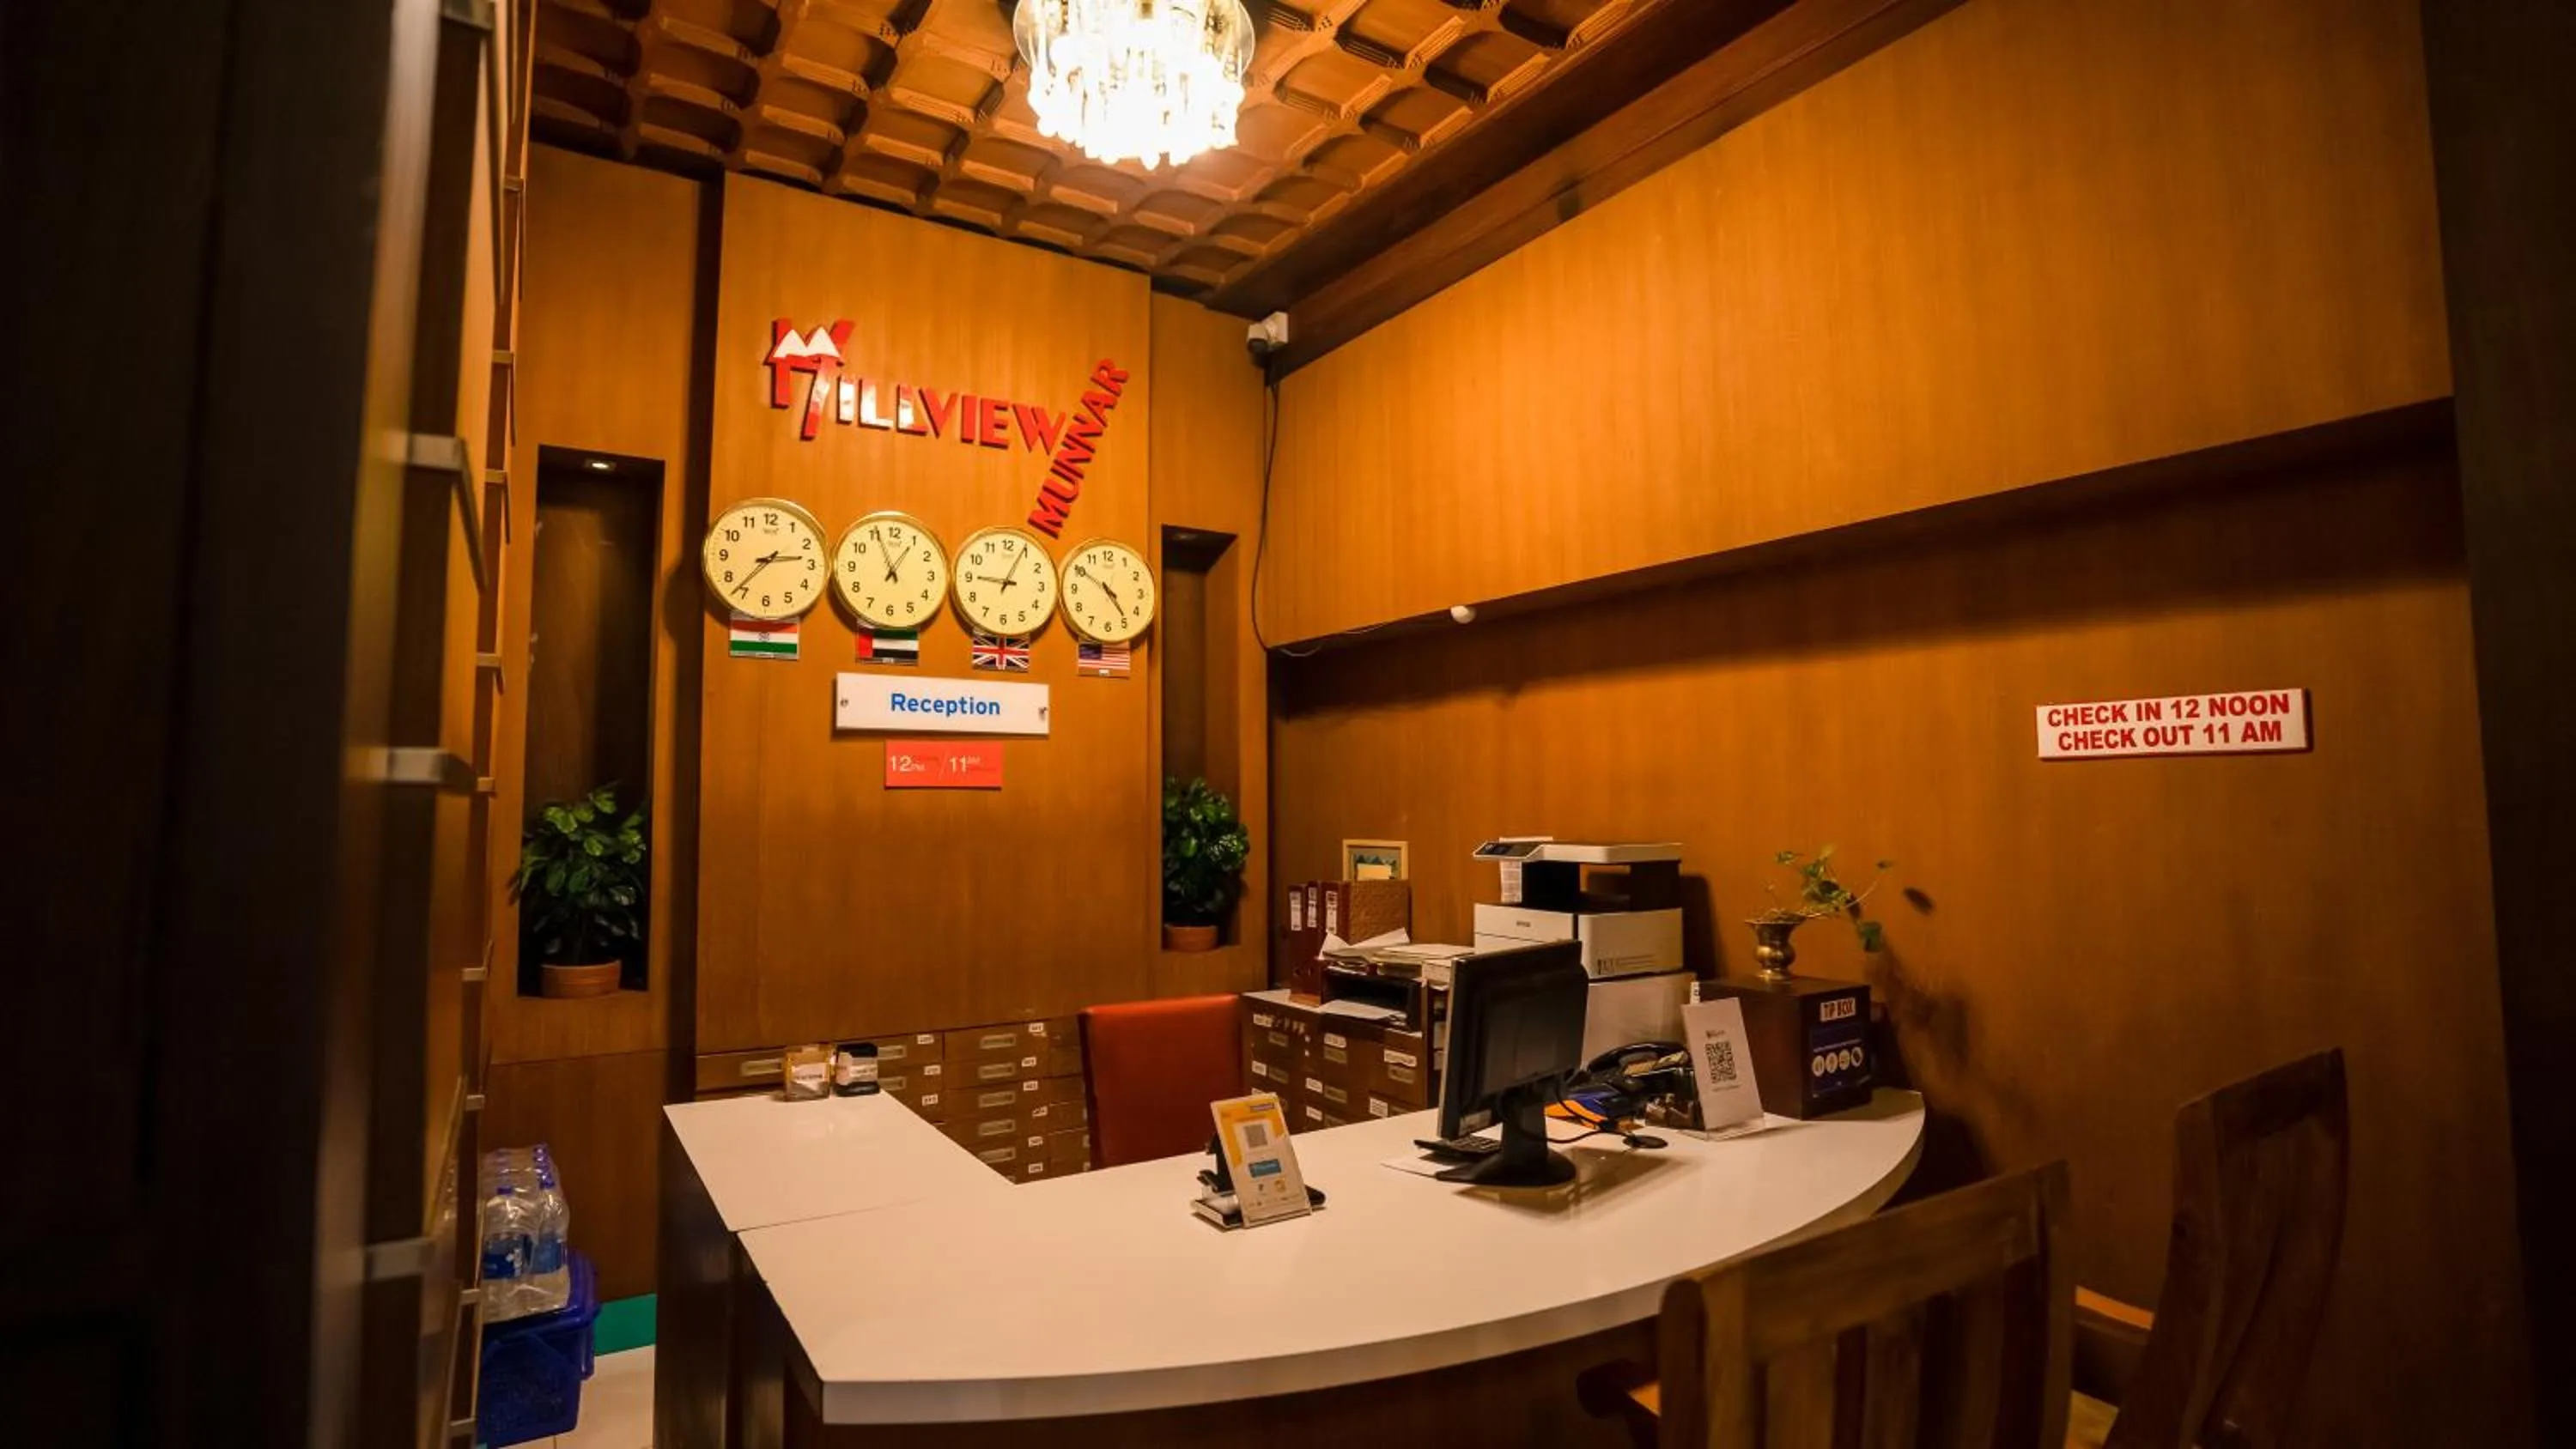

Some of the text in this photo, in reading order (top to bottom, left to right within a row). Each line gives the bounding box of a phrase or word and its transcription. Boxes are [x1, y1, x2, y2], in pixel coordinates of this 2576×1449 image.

[1028, 357, 1129, 539] MUNNAR
[744, 517, 755, 528] 11
[764, 513, 779, 525] 12
[790, 522, 796, 532] 1
[726, 530, 739, 541] 10
[889, 527, 901, 539] 12
[803, 538, 811, 549] 2
[911, 535, 917, 546] 1
[1002, 541, 1014, 551] 12
[854, 543, 866, 554] 10
[985, 543, 995, 553] 11
[1023, 547, 1028, 558] 1
[719, 549, 728, 561] 9
[923, 551, 932, 561] 2
[971, 555, 982, 565] 10
[1087, 555, 1097, 564] 11
[1103, 551, 1114, 561] 12
[807, 560, 816, 570] 3
[848, 561, 855, 573] 9
[1122, 557, 1127, 567] 1
[1034, 563, 1042, 573] 2
[725, 572, 732, 582] 8
[927, 571, 935, 582] 3
[965, 573, 972, 582] 9
[1133, 572, 1139, 581] 2
[800, 579, 809, 590] 4
[852, 581, 860, 592] 8
[1038, 582, 1045, 592] 3
[1072, 584, 1078, 593] 9
[738, 586, 749, 599] 7
[784, 591, 793, 603] 5
[921, 590, 928, 599] 4
[969, 592, 976, 602] 8
[1138, 589, 1144, 599] 3
[762, 596, 770, 606] 6
[866, 597, 874, 608] 7
[1032, 599, 1039, 609] 4
[886, 605, 894, 616] 6
[906, 602, 914, 613] 5
[982, 607, 990, 617] 7
[1075, 603, 1082, 612] 8
[1133, 606, 1139, 615] 4
[999, 615, 1007, 625] 6
[1018, 611, 1025, 622] 5
[1088, 616, 1095, 626] 7
[1104, 621, 1112, 632] 6
[1121, 617, 1127, 628] 5
[890, 693, 1000, 717] Reception
[2047, 694, 2290, 727] CHECK IN 12 NOON
[2058, 720, 2282, 751] CHECK OUT 11 AM
[1823, 999, 1854, 1019] TIP BOX
